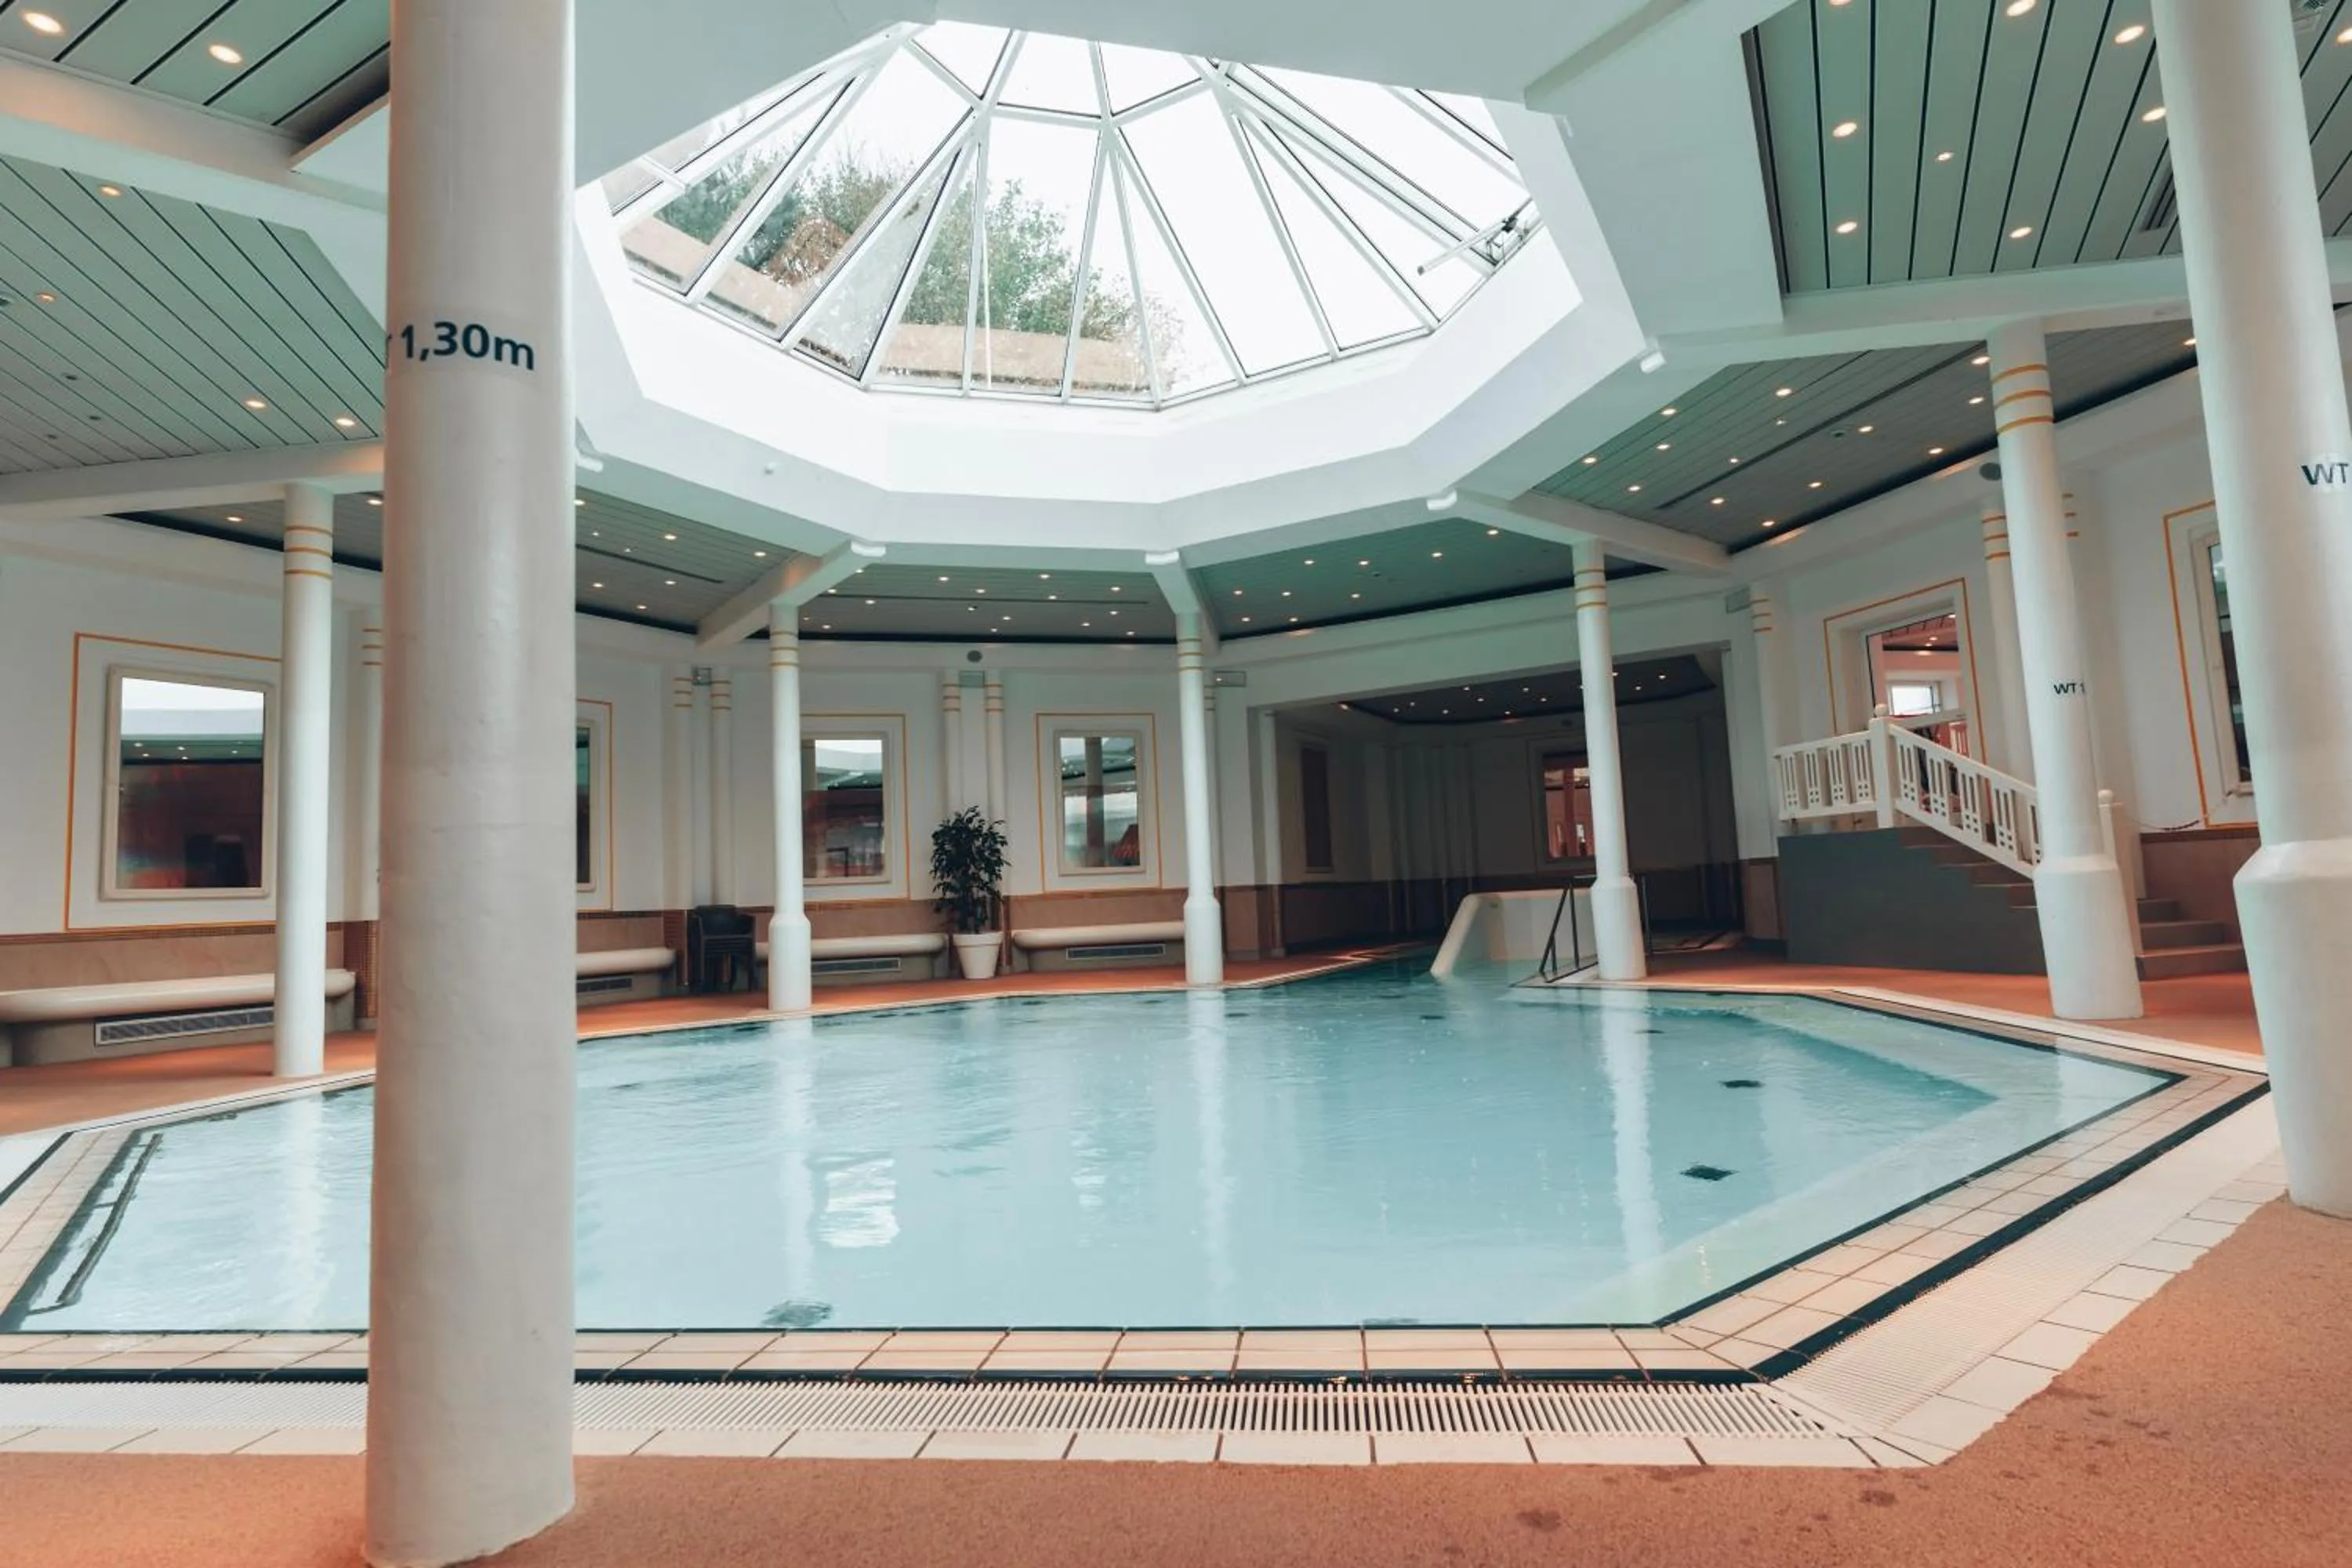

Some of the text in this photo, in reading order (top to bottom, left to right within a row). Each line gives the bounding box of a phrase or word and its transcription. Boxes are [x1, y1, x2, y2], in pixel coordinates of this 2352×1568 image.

[401, 321, 535, 371] 1,30m
[2300, 462, 2350, 485] WT
[2053, 682, 2077, 695] WT
